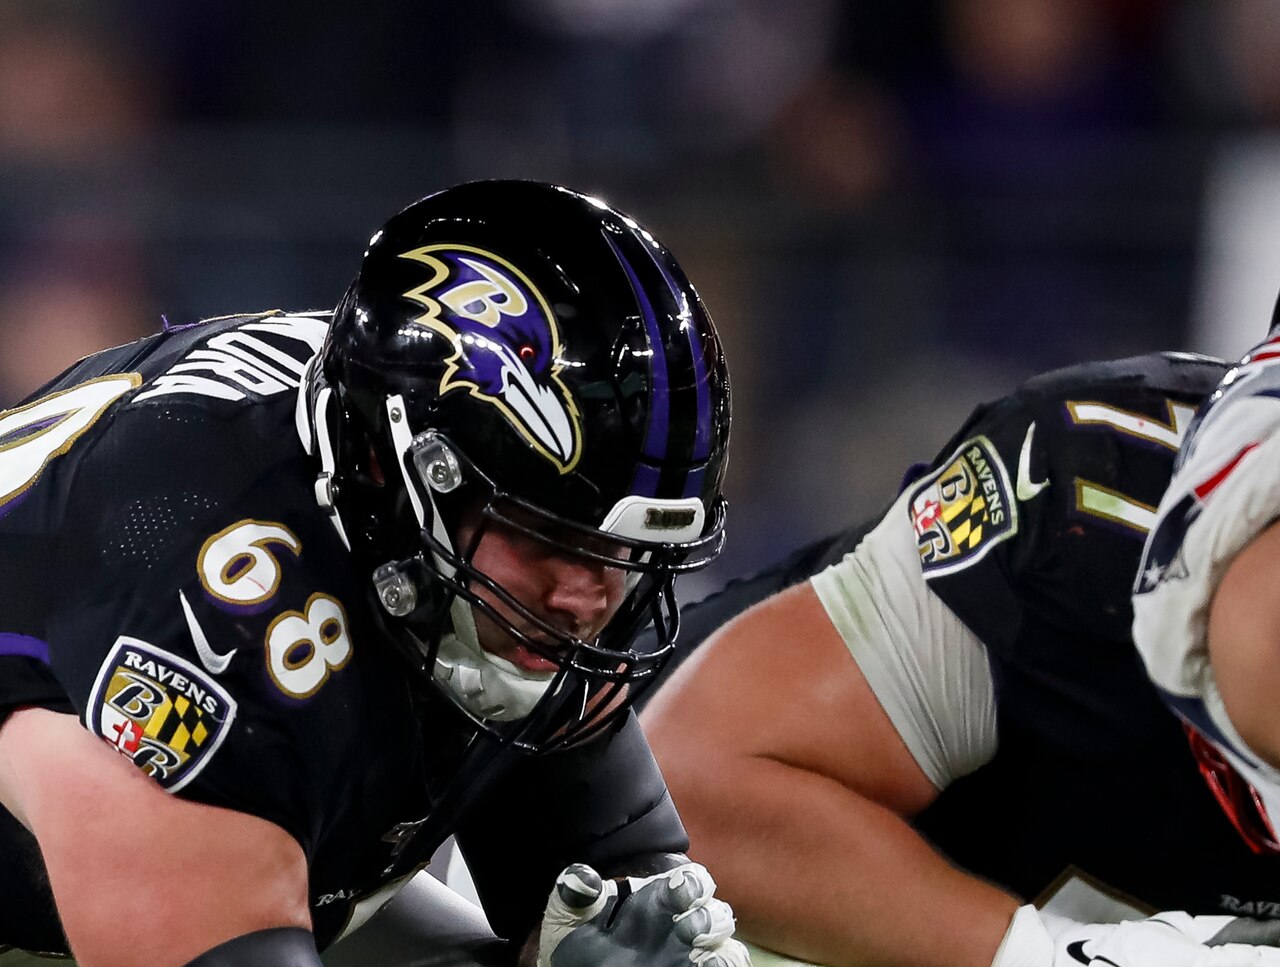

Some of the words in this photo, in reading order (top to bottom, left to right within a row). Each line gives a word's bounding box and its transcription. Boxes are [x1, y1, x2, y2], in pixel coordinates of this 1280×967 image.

[967, 446, 1006, 525] RAVENS
[197, 518, 353, 699] 68
[124, 651, 218, 714] RAVENS
